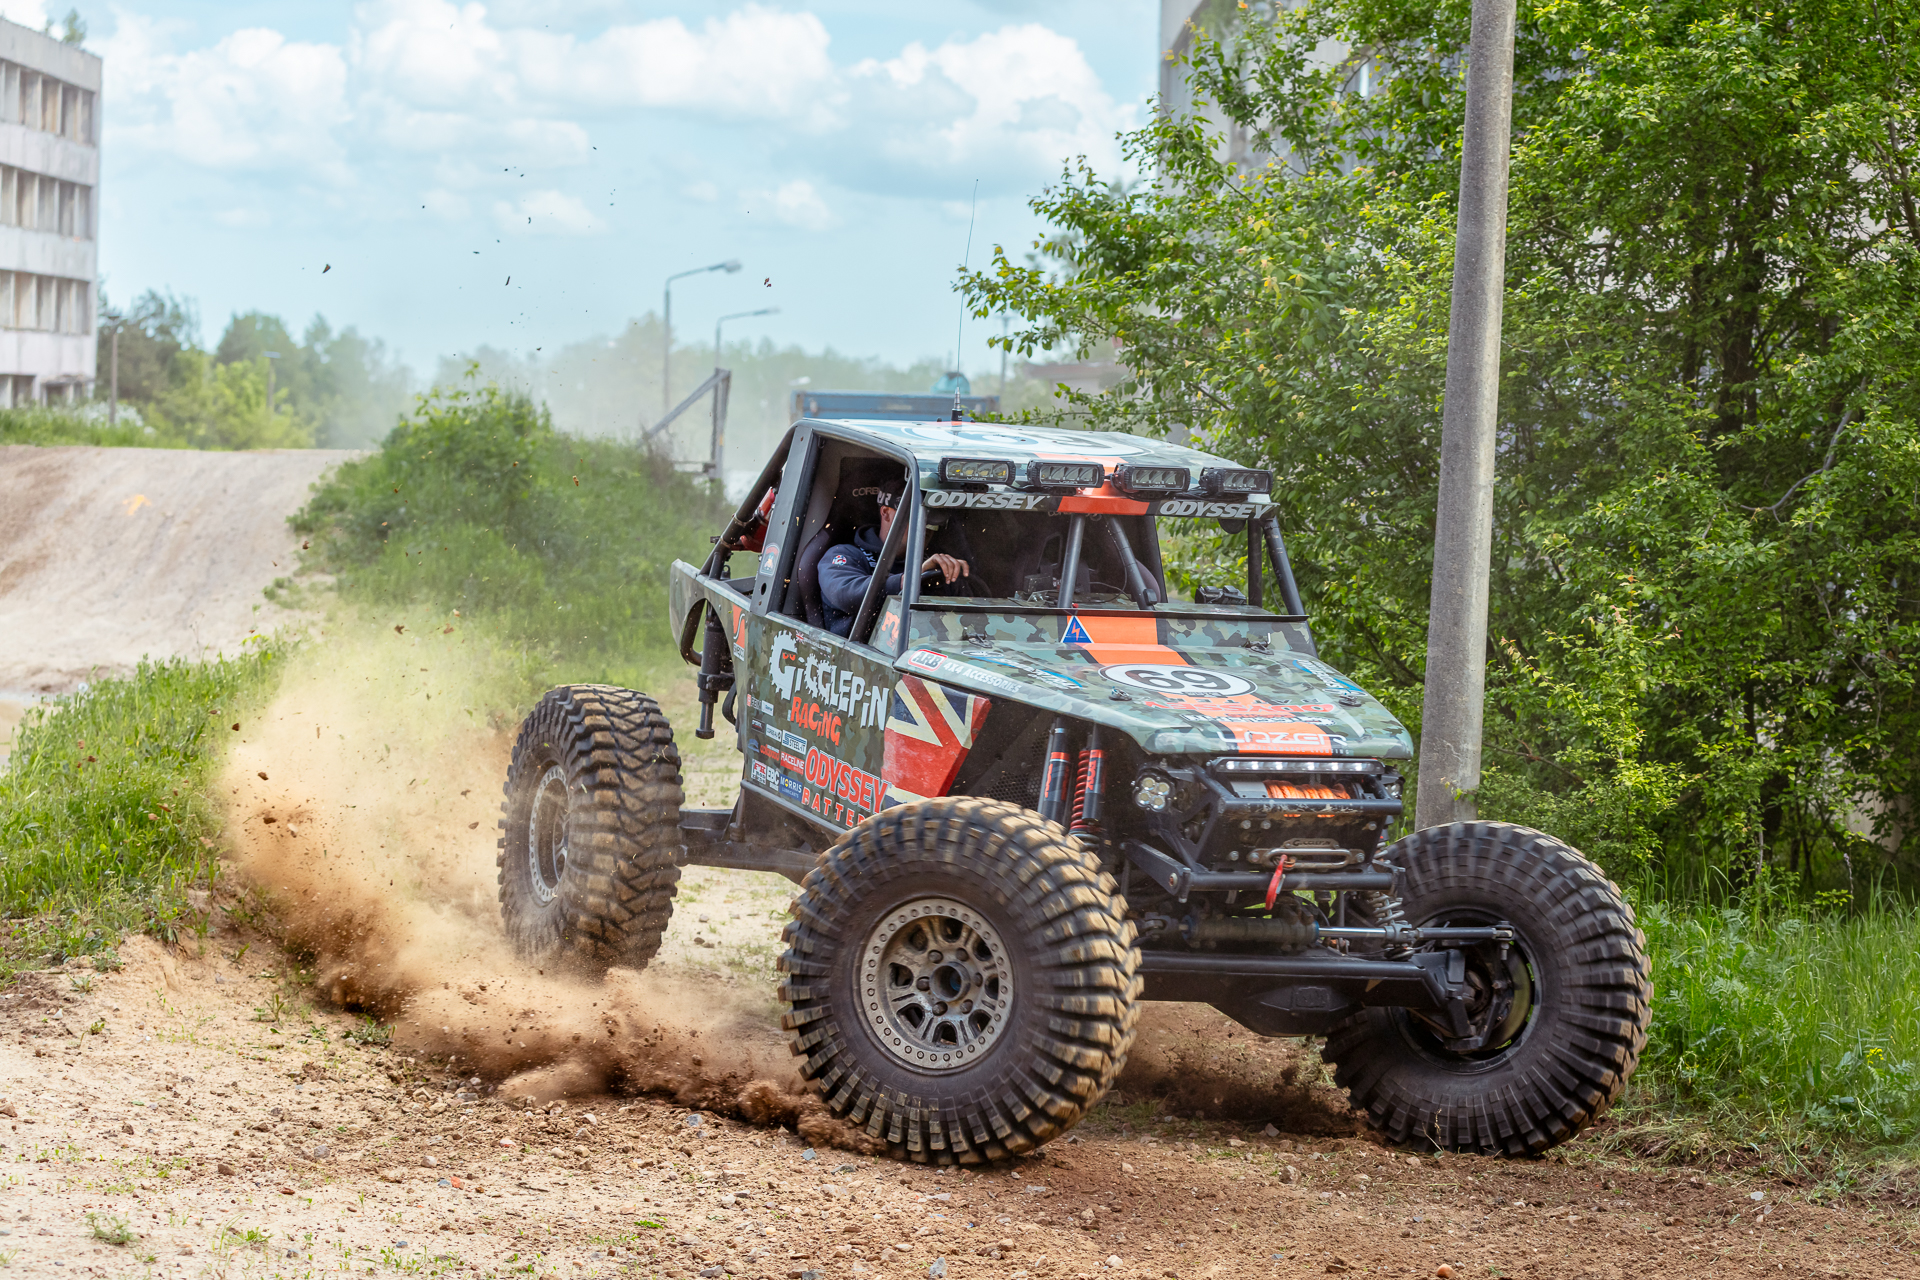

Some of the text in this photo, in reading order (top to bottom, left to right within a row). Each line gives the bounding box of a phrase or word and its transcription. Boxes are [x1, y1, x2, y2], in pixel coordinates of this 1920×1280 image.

[927, 491, 1045, 509] ODYSSEY
[1159, 500, 1274, 519] ODYSSEY
[912, 652, 942, 668] ARB
[962, 668, 1022, 693] ACCESSORIES
[1124, 670, 1232, 690] 69
[1143, 701, 1335, 713] ODYSSEY
[781, 752, 804, 770] RACELINE
[1310, 748, 1351, 756] LIGHTING
[767, 766, 780, 785] EBC
[780, 776, 802, 793] MORRIS
[805, 746, 890, 814] ODYSSEY
